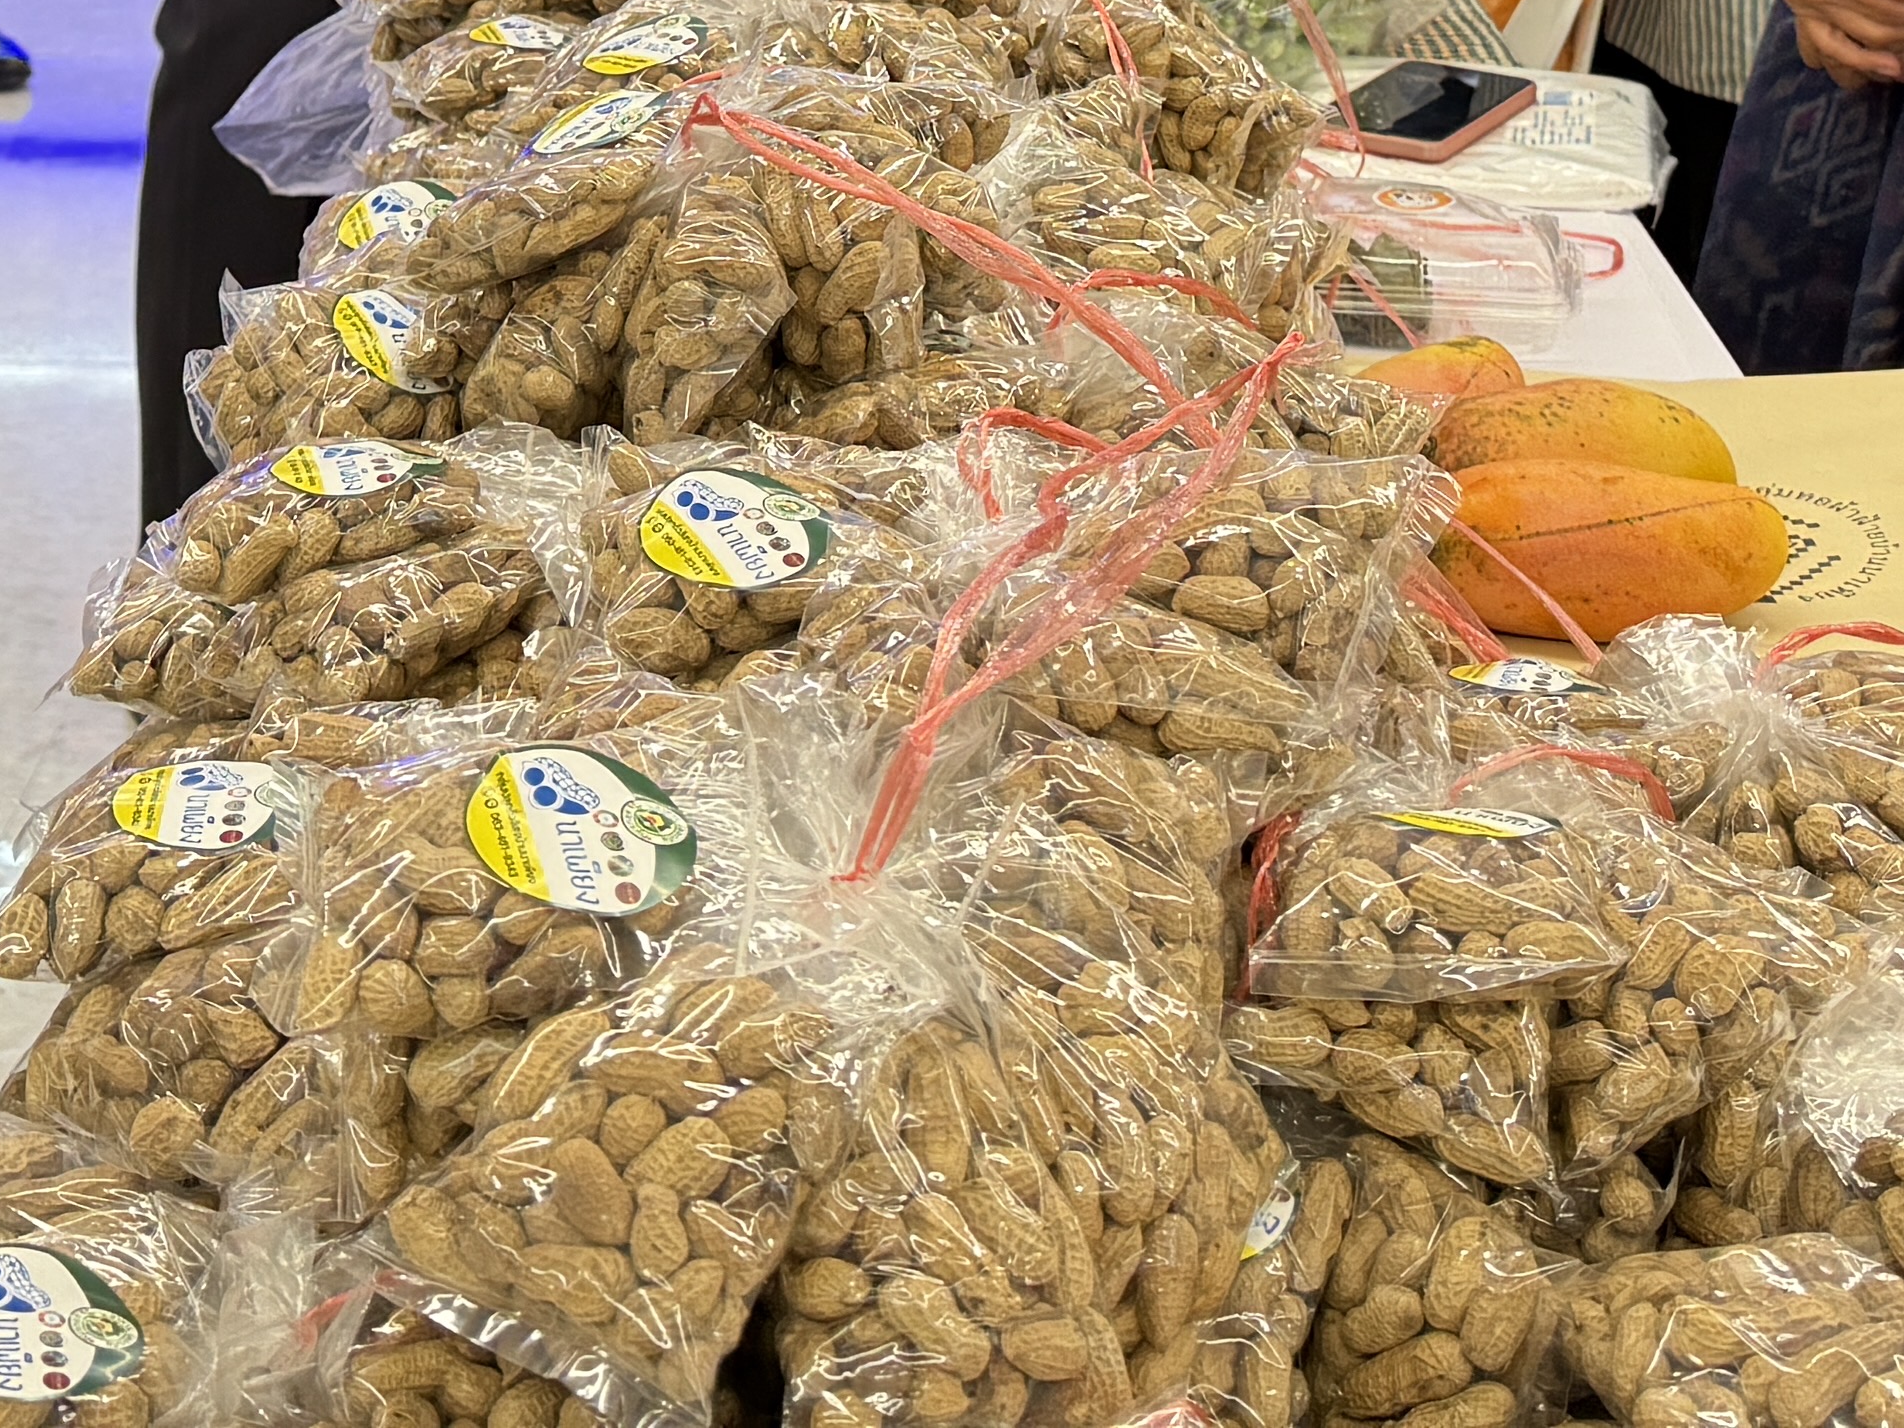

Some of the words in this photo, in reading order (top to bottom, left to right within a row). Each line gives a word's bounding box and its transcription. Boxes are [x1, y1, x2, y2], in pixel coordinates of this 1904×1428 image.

[717, 524, 773, 581] นาเพียง
[179, 794, 215, 844] นาเพียง
[554, 822, 600, 905] นาเพียง
